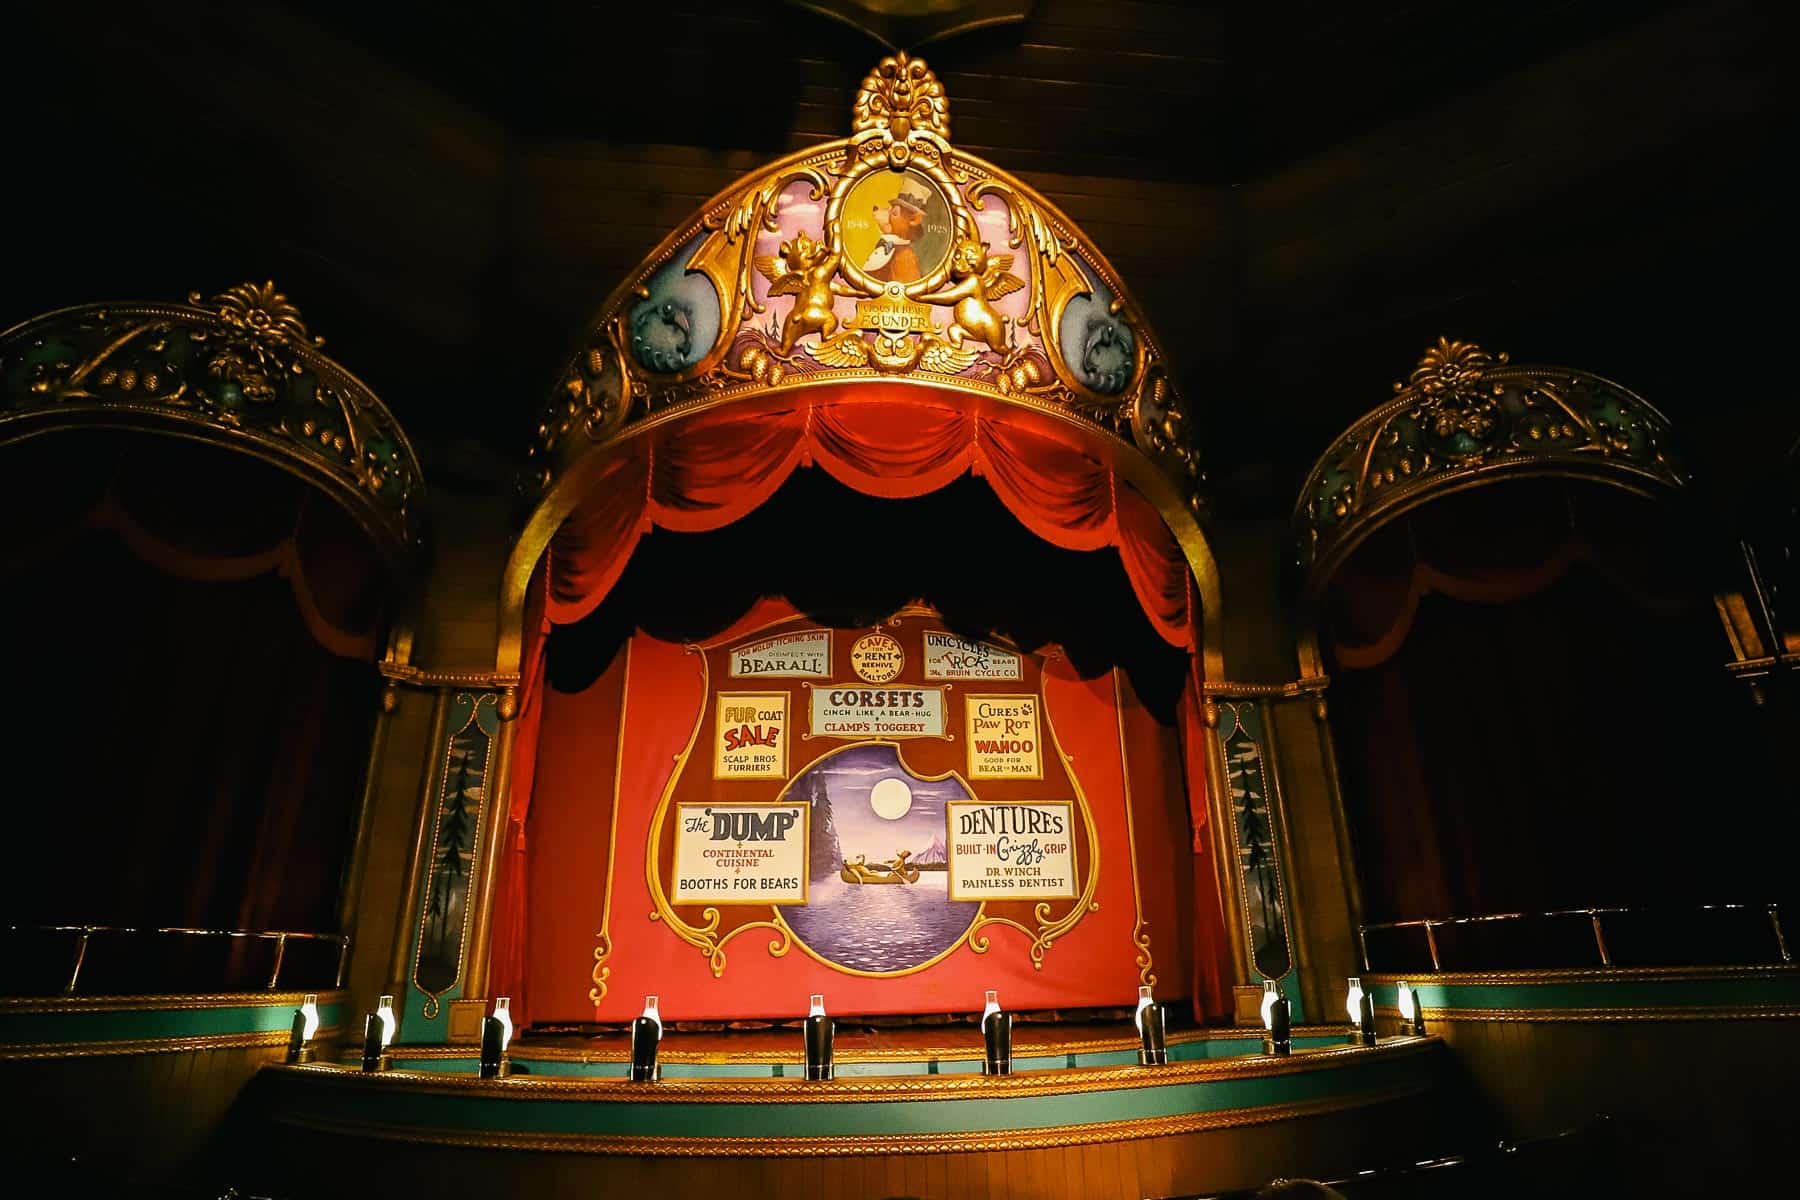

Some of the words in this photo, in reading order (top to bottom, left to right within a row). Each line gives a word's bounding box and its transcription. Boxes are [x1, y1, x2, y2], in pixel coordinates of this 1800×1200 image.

[863, 314, 929, 328] FOUNDER
[807, 633, 825, 641] SKIN
[860, 637, 897, 650] CAVES
[928, 635, 990, 657] UNICYCLES
[864, 652, 893, 661] RENT
[941, 651, 989, 670] TRICK
[859, 668, 897, 681] REALTORS
[946, 669, 970, 677] BRUIN
[829, 690, 924, 708] CORSETS
[725, 705, 757, 723] FUR
[758, 710, 784, 721] COAT
[824, 721, 870, 732] CLAMP'S
[875, 722, 926, 732] TOGGERY
[723, 724, 780, 752] SALE
[974, 740, 1034, 754] WAHOO
[723, 754, 749, 763] SCALP
[728, 764, 771, 772] FURRIERS
[978, 764, 1003, 773] BEAR
[1011, 764, 1033, 773] MAN
[960, 806, 1064, 835] DENTURES
[702, 849, 775, 858] CONTINENTAL
[996, 836, 1046, 865] Grizzly
[1044, 843, 1068, 855] GRIP
[716, 858, 760, 867] CUISINE
[1004, 867, 1041, 876] WINCH
[680, 878, 728, 890] BOOTHS
[733, 878, 757, 890] FOR
[760, 877, 799, 890] BEARS
[962, 879, 1015, 889] PAINLESS
[1019, 878, 1065, 888] DENTIST
